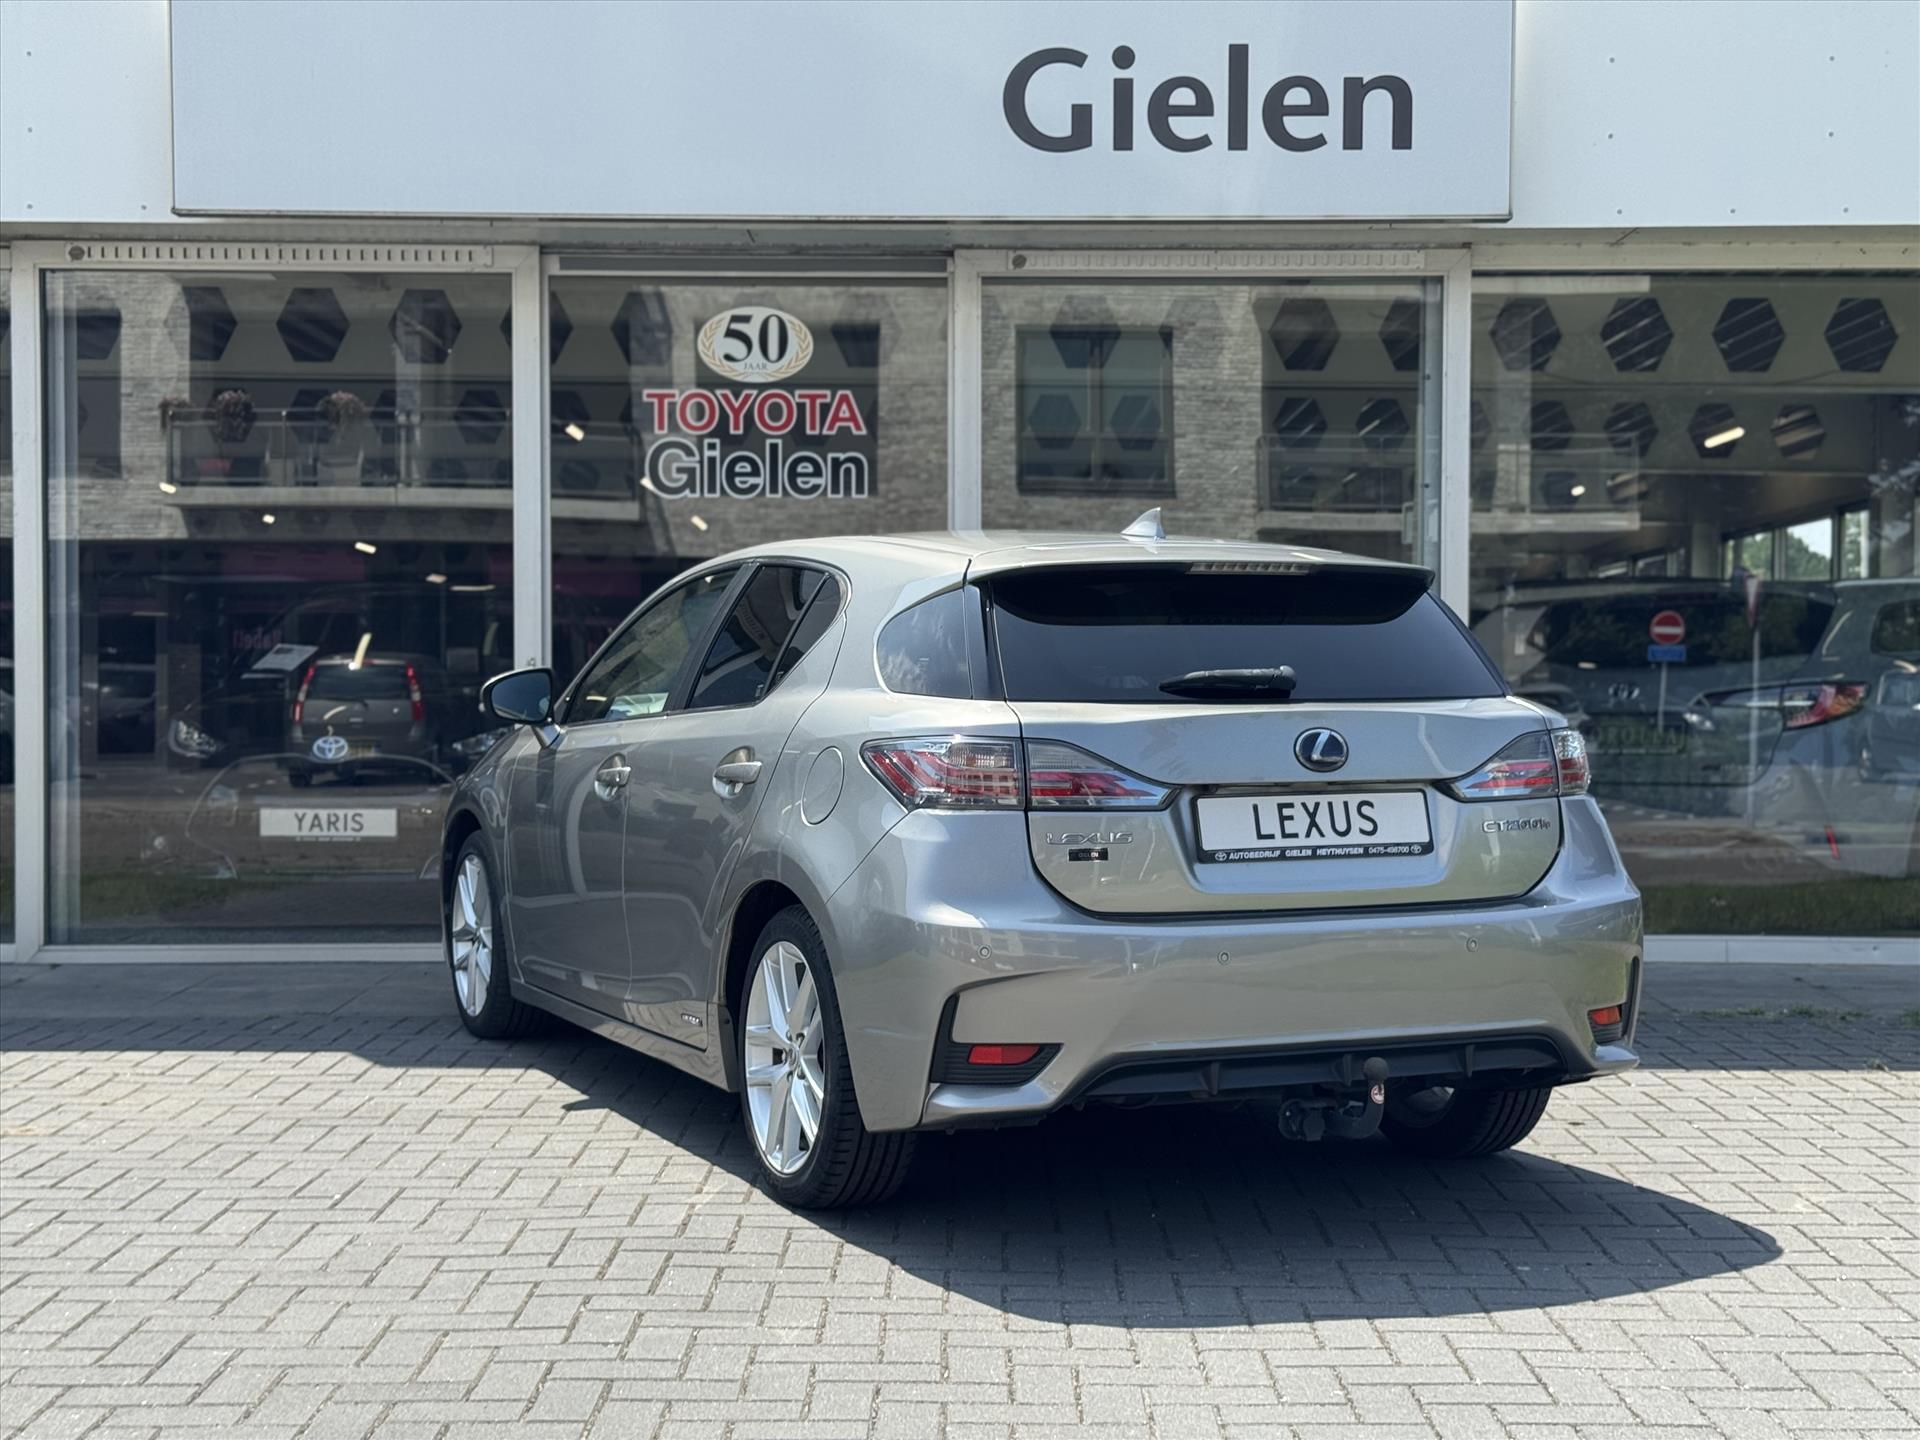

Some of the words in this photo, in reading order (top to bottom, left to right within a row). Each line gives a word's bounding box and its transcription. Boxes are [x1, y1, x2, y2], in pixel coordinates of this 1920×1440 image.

[1003, 44, 1413, 153] Gielen
[723, 314, 788, 363] 50
[744, 361, 768, 371] JAAR
[643, 389, 867, 435] TOYOTA
[645, 437, 868, 499] Gielen
[294, 812, 364, 833] YARIS
[1046, 831, 1134, 845] LEXUS
[1252, 799, 1378, 840] LEXUS
[1229, 850, 1281, 860] AUTOBEDRIJF
[1285, 848, 1312, 857] GIELEN
[1316, 847, 1364, 856] HEYTHUYSEN
